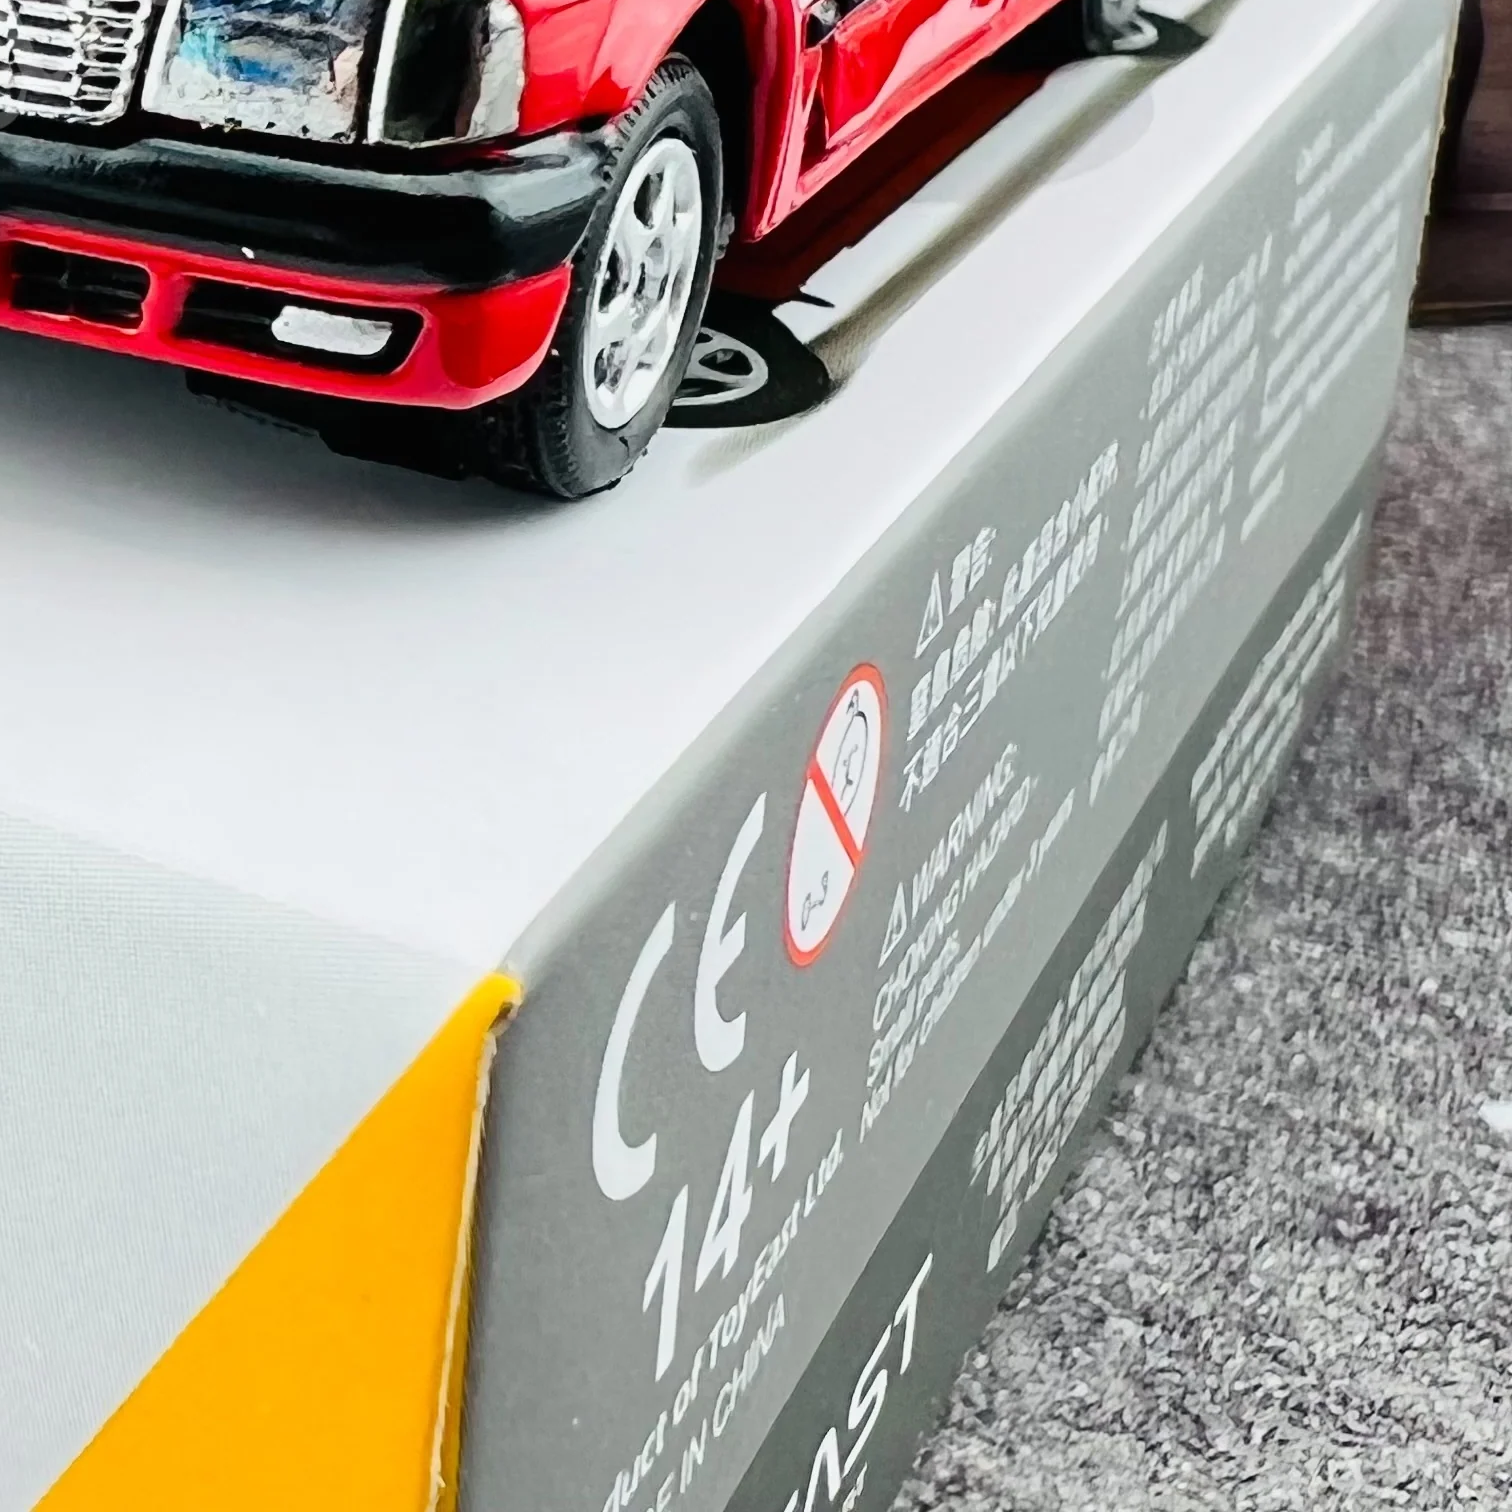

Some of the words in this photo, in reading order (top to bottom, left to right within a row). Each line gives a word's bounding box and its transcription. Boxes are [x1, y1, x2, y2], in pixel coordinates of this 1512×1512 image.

[591, 790, 768, 1201] CE
[601, 1410, 668, 1512] duct
[672, 1343, 706, 1425] of
[709, 1199, 801, 1370] ToyEast
[641, 1049, 810, 1382] 14+
[679, 1417, 708, 1495] IN
[713, 1292, 785, 1438] CHINA
[784, 1252, 934, 1512] AST
